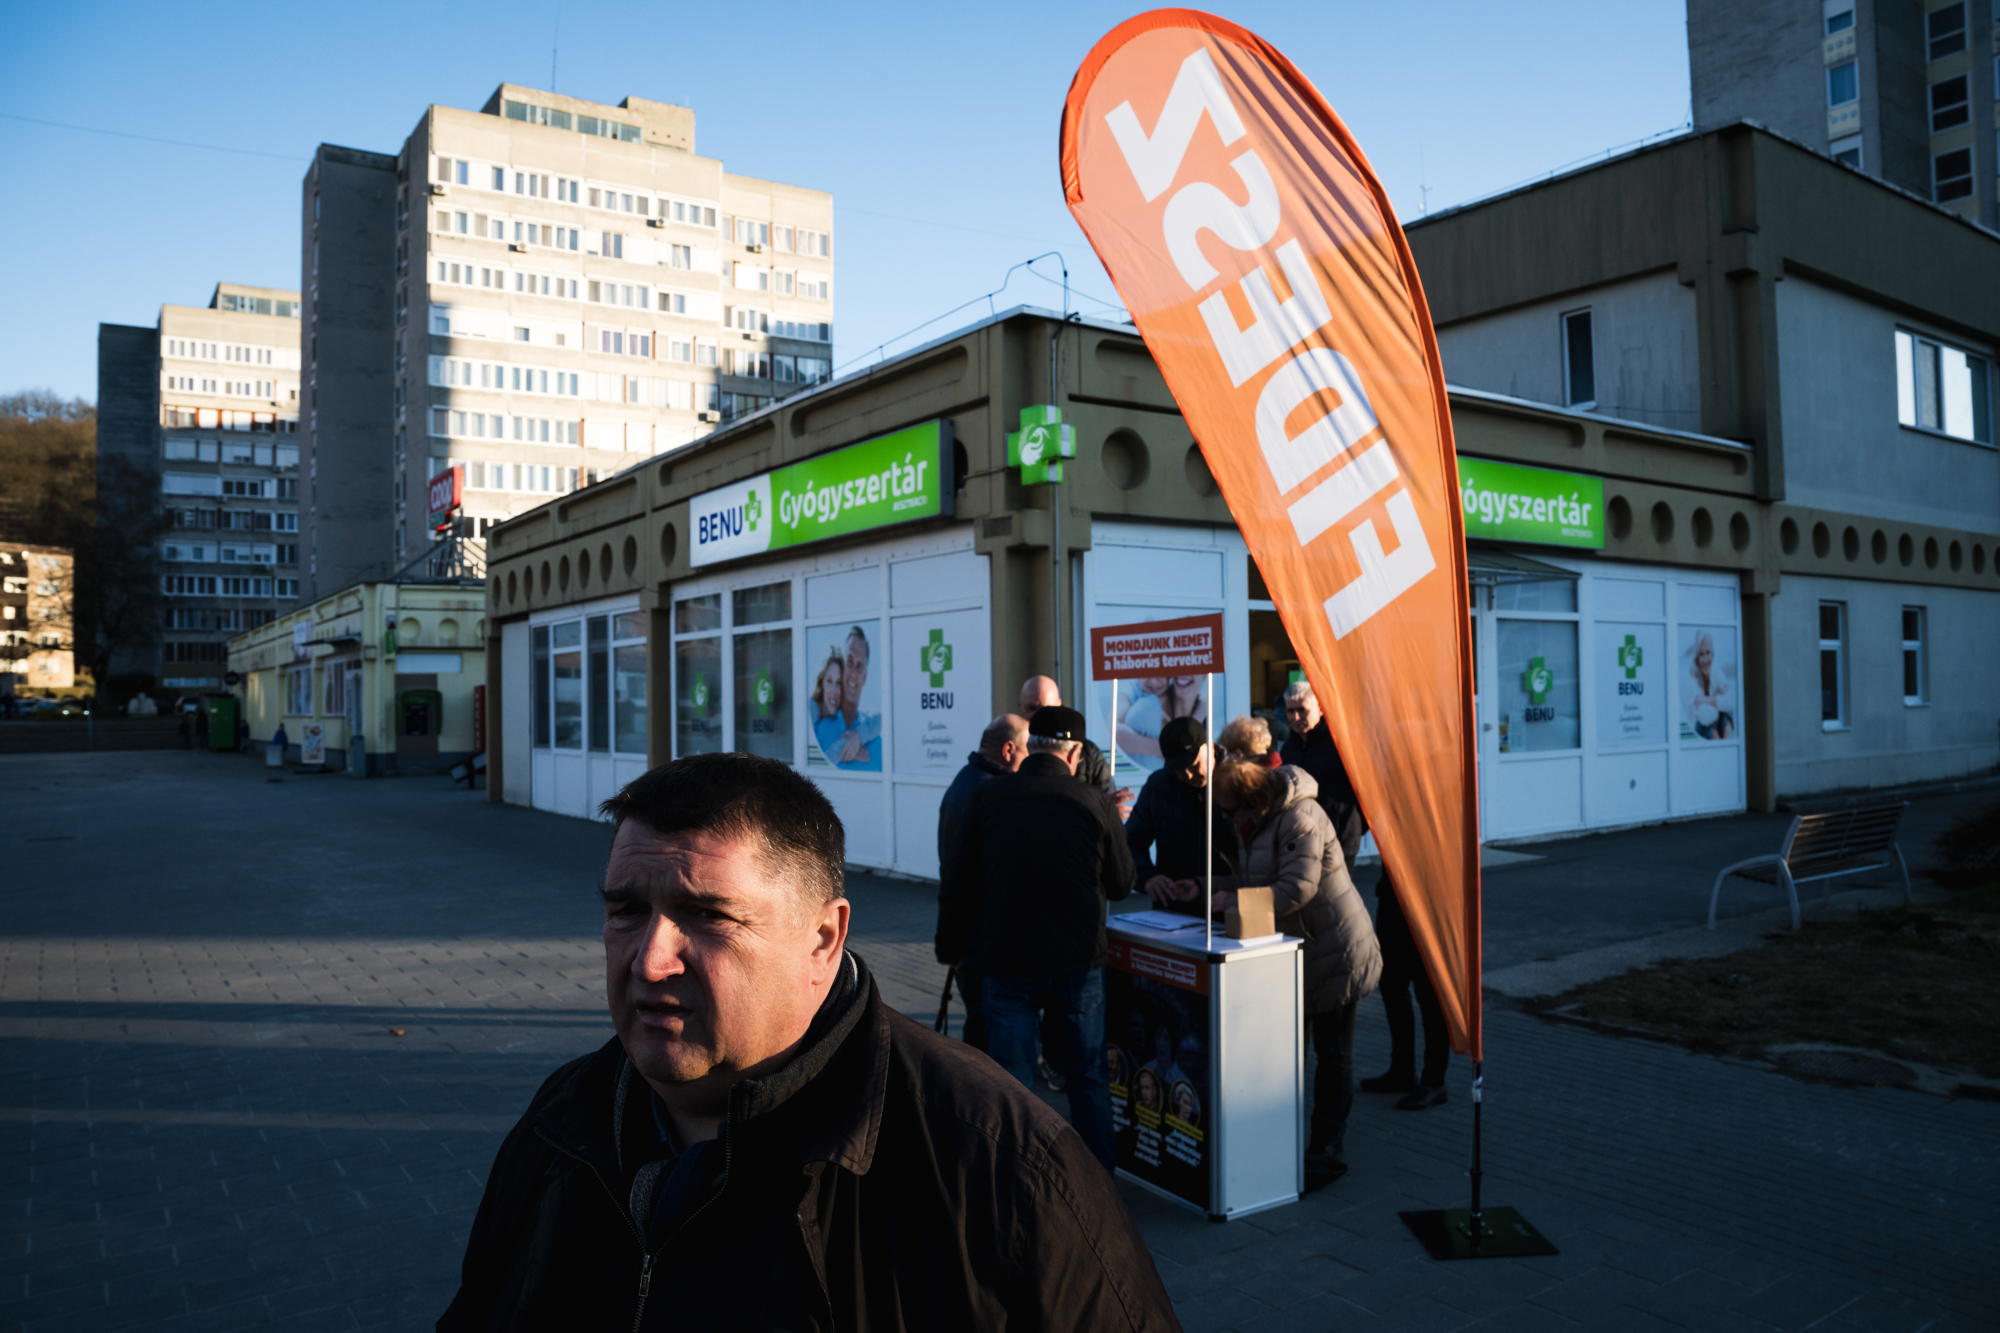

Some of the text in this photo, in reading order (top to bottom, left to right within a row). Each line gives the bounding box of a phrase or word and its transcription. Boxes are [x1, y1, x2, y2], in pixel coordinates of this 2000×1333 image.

[779, 452, 928, 529] Gyógyszertár
[1459, 478, 1592, 526] ógyszertár
[699, 504, 743, 544] BENU
[1106, 633, 1210, 653] MONDJUNK NEMET
[1103, 651, 1213, 671] a háborús tervekre!
[1617, 681, 1645, 696] BENU
[920, 691, 955, 710] BENU
[1524, 706, 1555, 723] BENU
[752, 718, 775, 733] BENU
